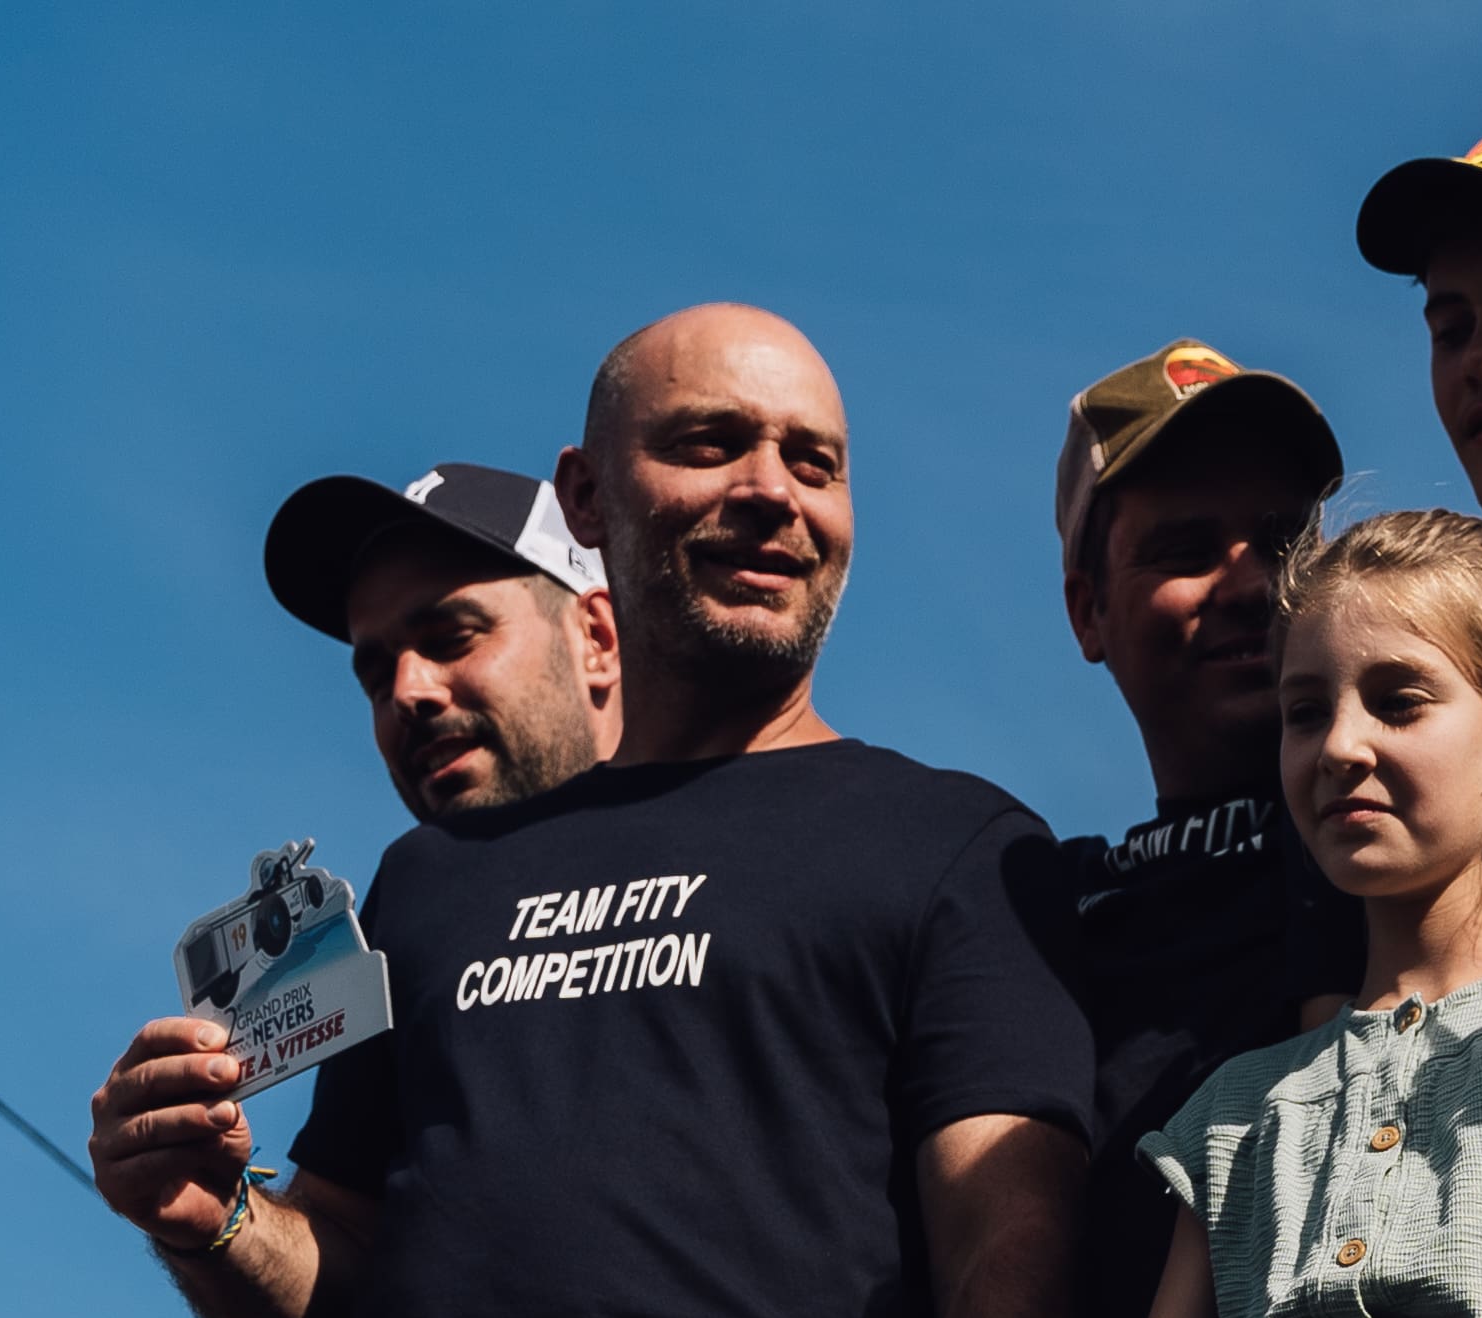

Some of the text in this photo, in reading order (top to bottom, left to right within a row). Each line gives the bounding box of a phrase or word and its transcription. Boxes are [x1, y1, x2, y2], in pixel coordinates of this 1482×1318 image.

[508, 874, 707, 943] TEAM FITY
[230, 923, 248, 953] 19
[455, 933, 711, 1011] COMPETITION
[236, 998, 281, 1030] GRAND
[283, 982, 313, 1009] PRIX
[252, 999, 315, 1046] NEVERS
[276, 1013, 345, 1062] VITESSE
